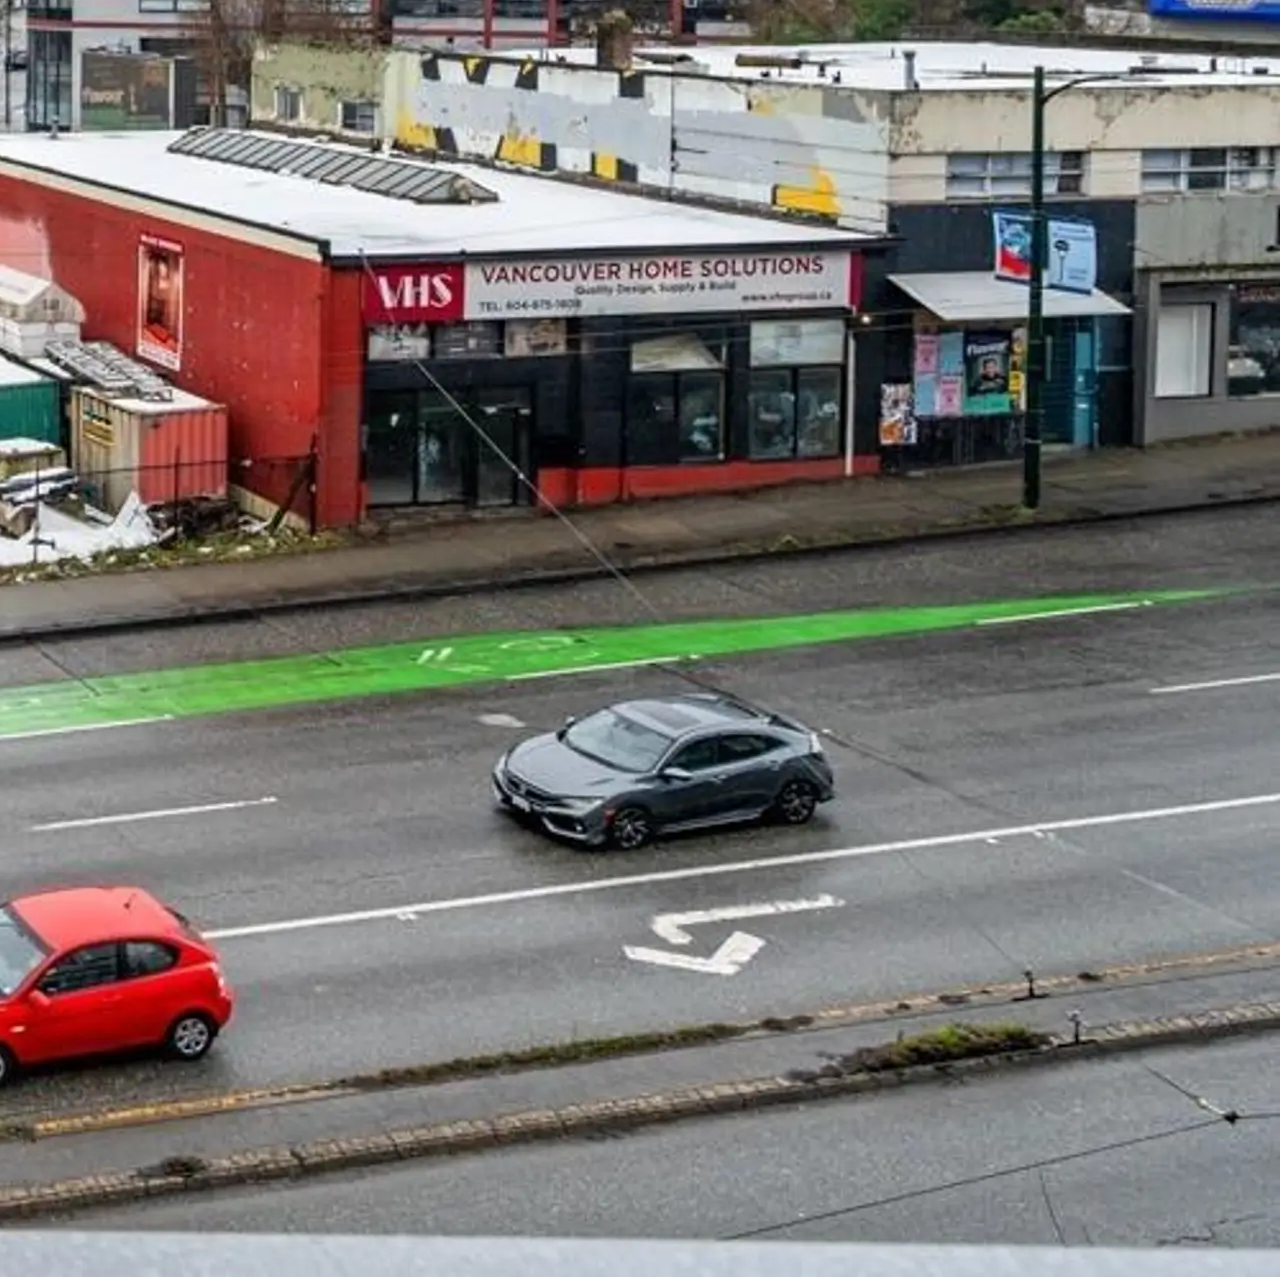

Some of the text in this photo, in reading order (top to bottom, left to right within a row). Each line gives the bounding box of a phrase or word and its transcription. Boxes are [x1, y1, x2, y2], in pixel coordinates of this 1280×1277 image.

[377, 255, 825, 310] VHS VANCOUVER HOME SOLUTIONS
[573, 284, 614, 297] Quality
[616, 283, 657, 296] Design,
[659, 281, 695, 294] Supply
[708, 279, 737, 291] Build
